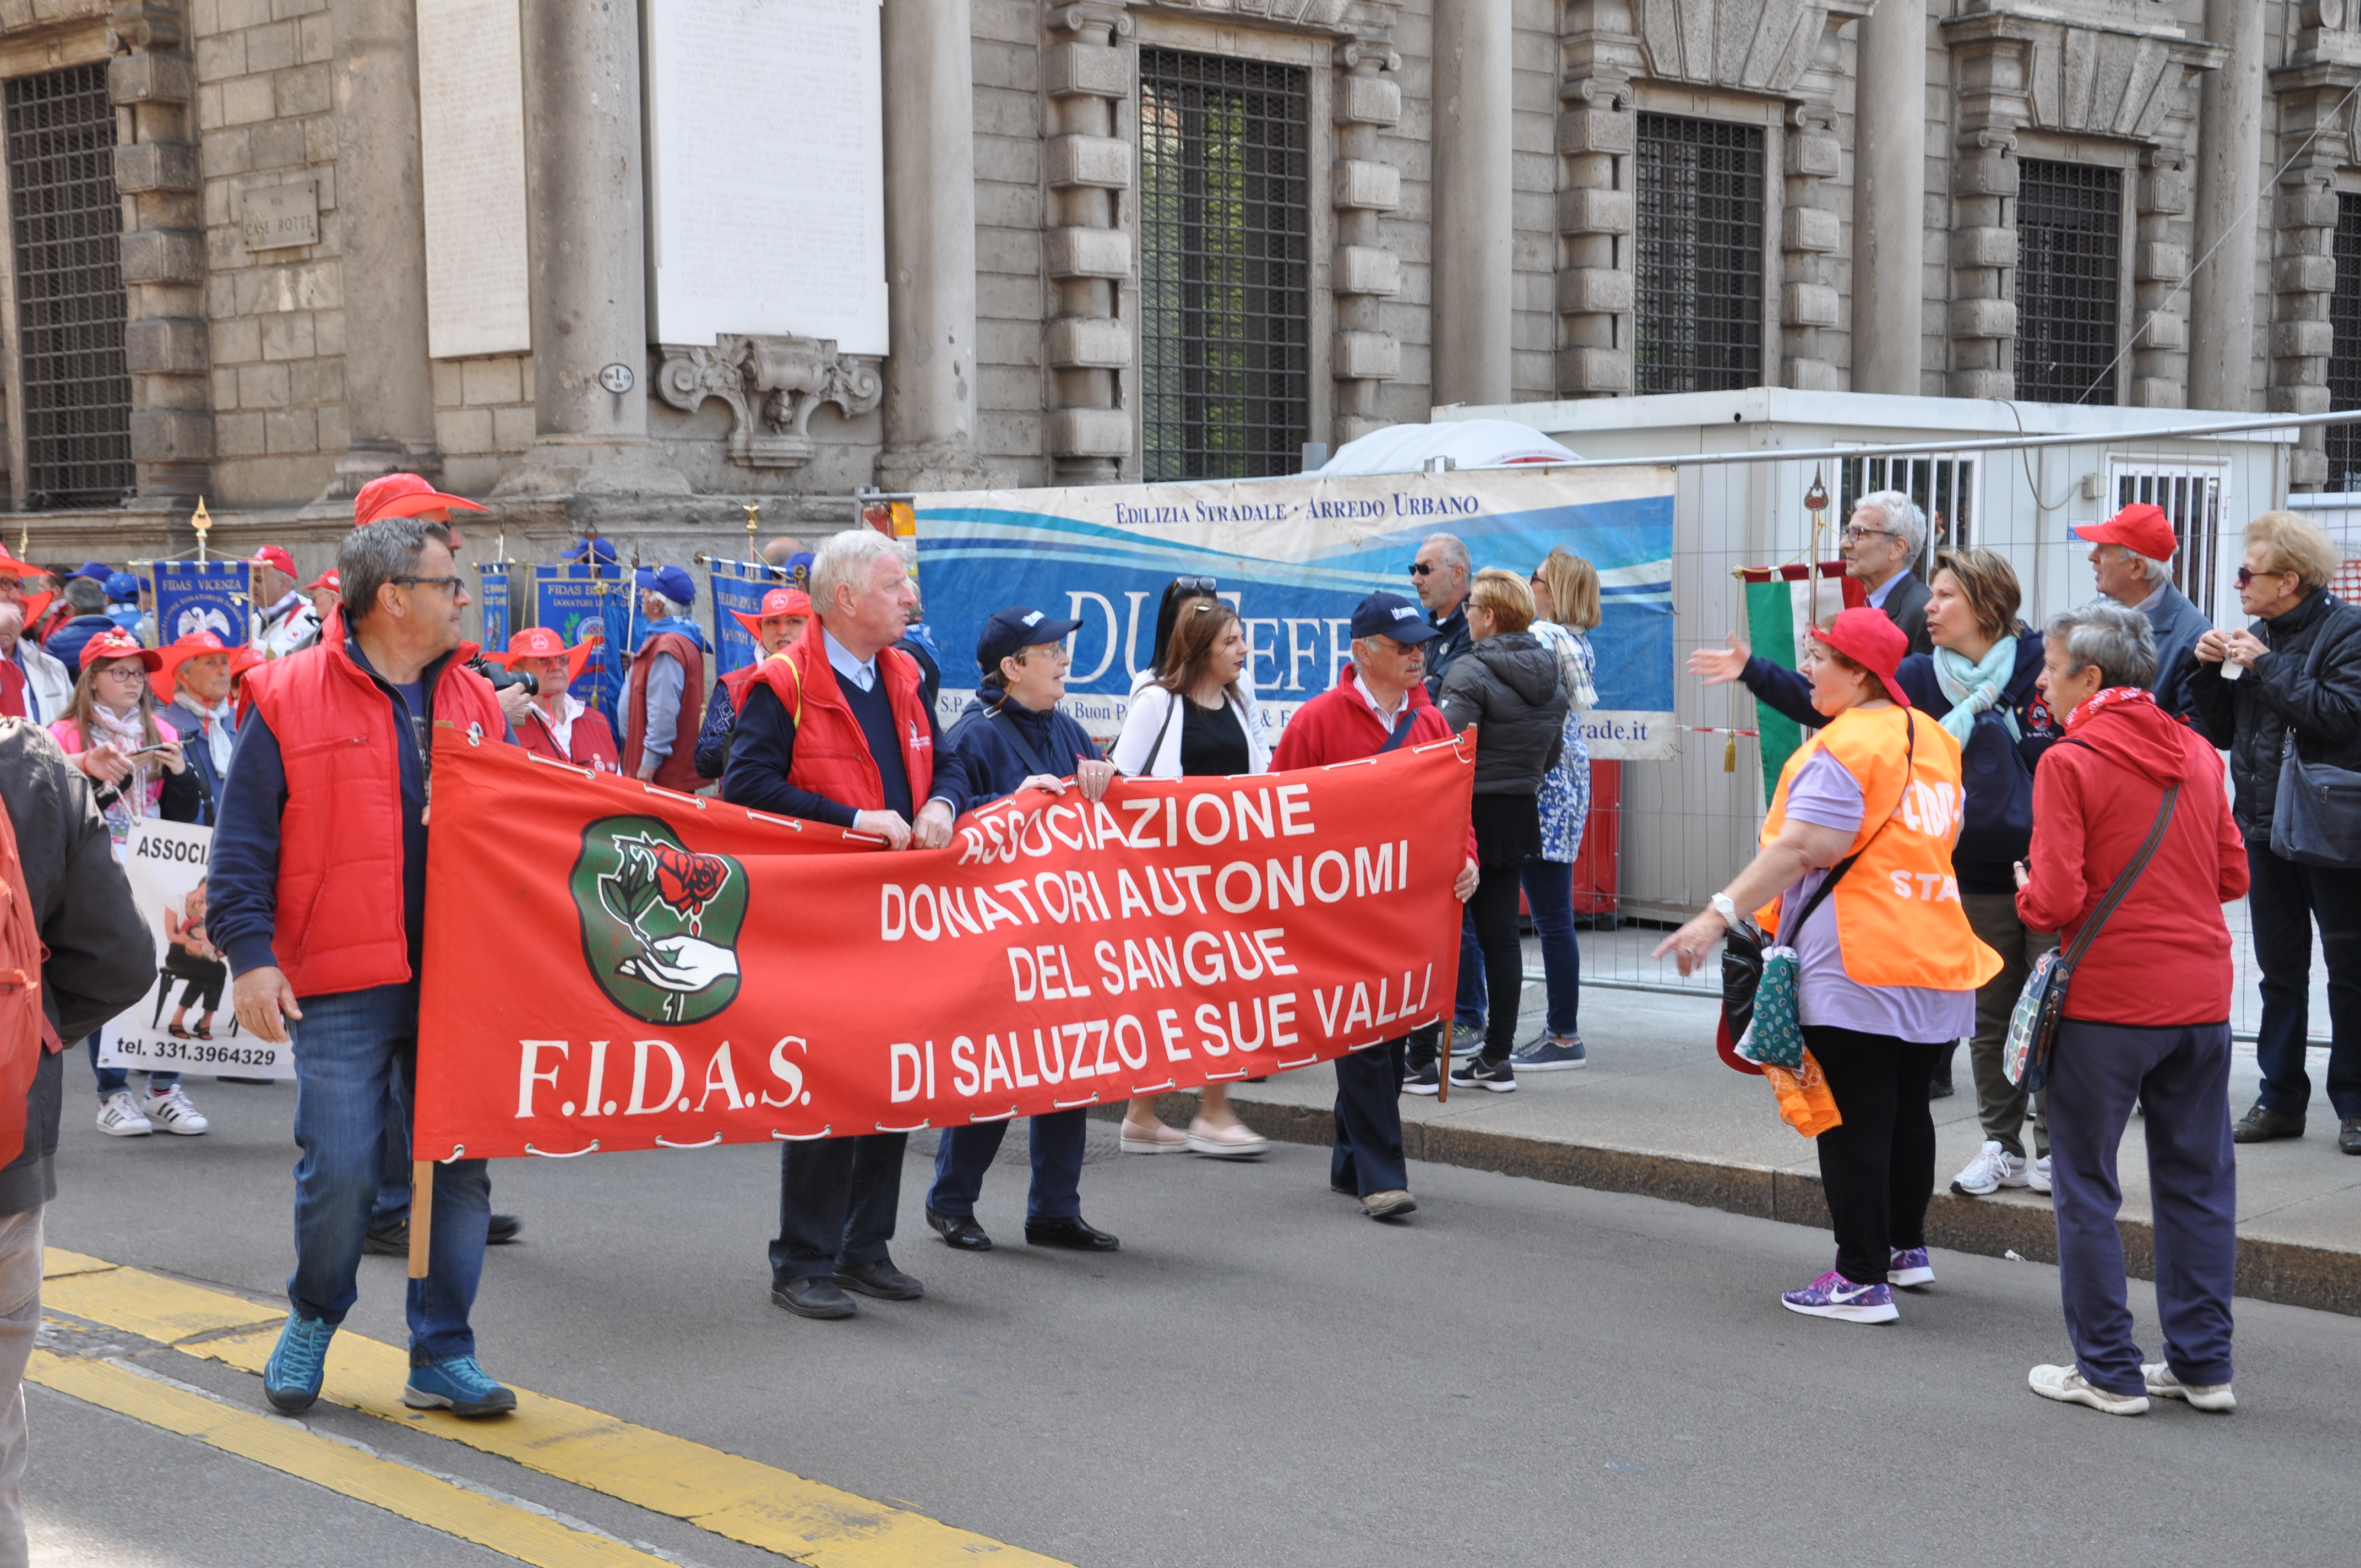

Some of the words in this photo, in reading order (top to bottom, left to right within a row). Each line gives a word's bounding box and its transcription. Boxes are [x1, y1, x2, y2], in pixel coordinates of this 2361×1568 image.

[270, 197, 282, 205] VIA
[246, 221, 270, 236] CASE
[278, 215, 312, 232] ROTTE
[162, 580, 192, 591] FIDAS
[198, 579, 242, 591] VICENZA
[548, 585, 581, 595] FIDAS
[553, 598, 592, 607] DONATORI
[1074, 701, 1110, 719] Buon
[958, 783, 1315, 865] ASSOCIAZIONE
[137, 836, 209, 866] ASSOCI
[881, 870, 1112, 942] DONATORI
[1117, 839, 1408, 919] AUTONOMI
[1007, 944, 1092, 1003] DEL
[1094, 927, 1299, 996] SANGUE
[890, 1040, 935, 1103] DI
[951, 1014, 1147, 1097] SALUZZO
[1156, 1008, 1193, 1063] E
[1194, 992, 1299, 1057] SUE
[1312, 962, 1433, 1038] VALLI
[117, 1037, 146, 1056] tel.
[154, 1041, 276, 1065] 331.3964329
[514, 1035, 811, 1119] F.I.D.A.S.
